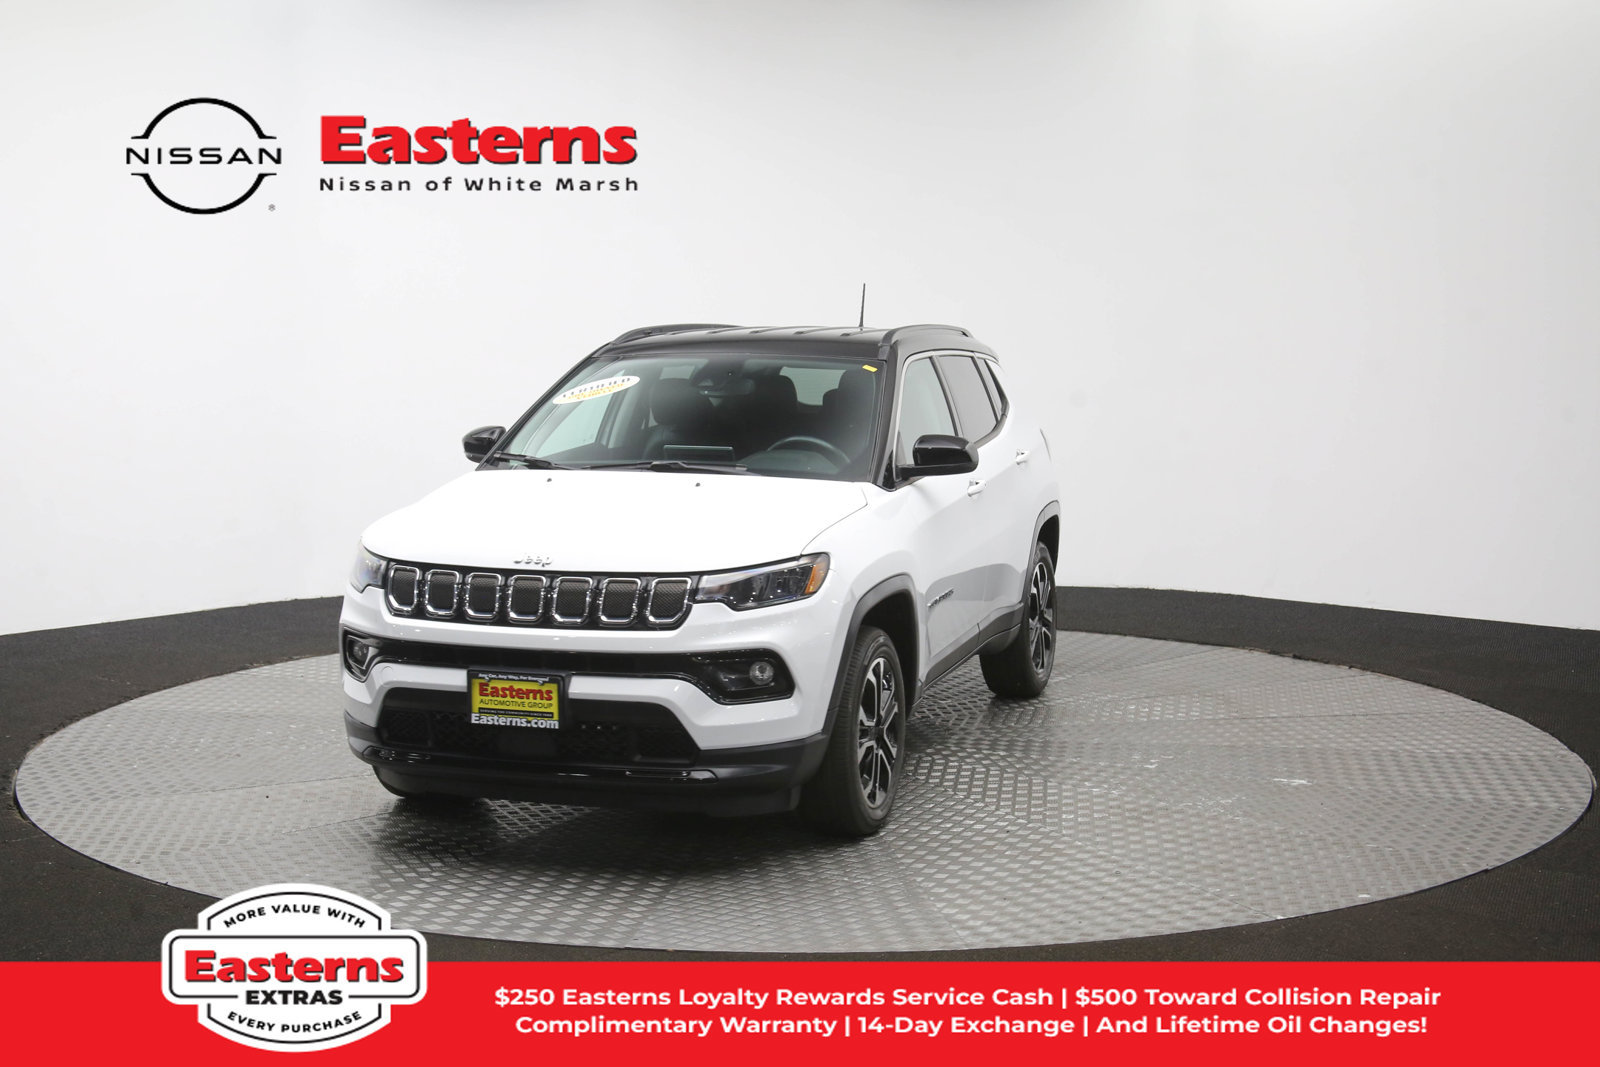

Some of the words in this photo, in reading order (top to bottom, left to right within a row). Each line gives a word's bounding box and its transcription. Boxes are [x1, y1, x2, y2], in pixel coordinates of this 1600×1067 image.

[513, 553, 553, 568] Jeep
[479, 682, 553, 701] Easterns
[480, 699, 526, 707] AUTOMOTIVE
[471, 713, 559, 729] Easterns.com
